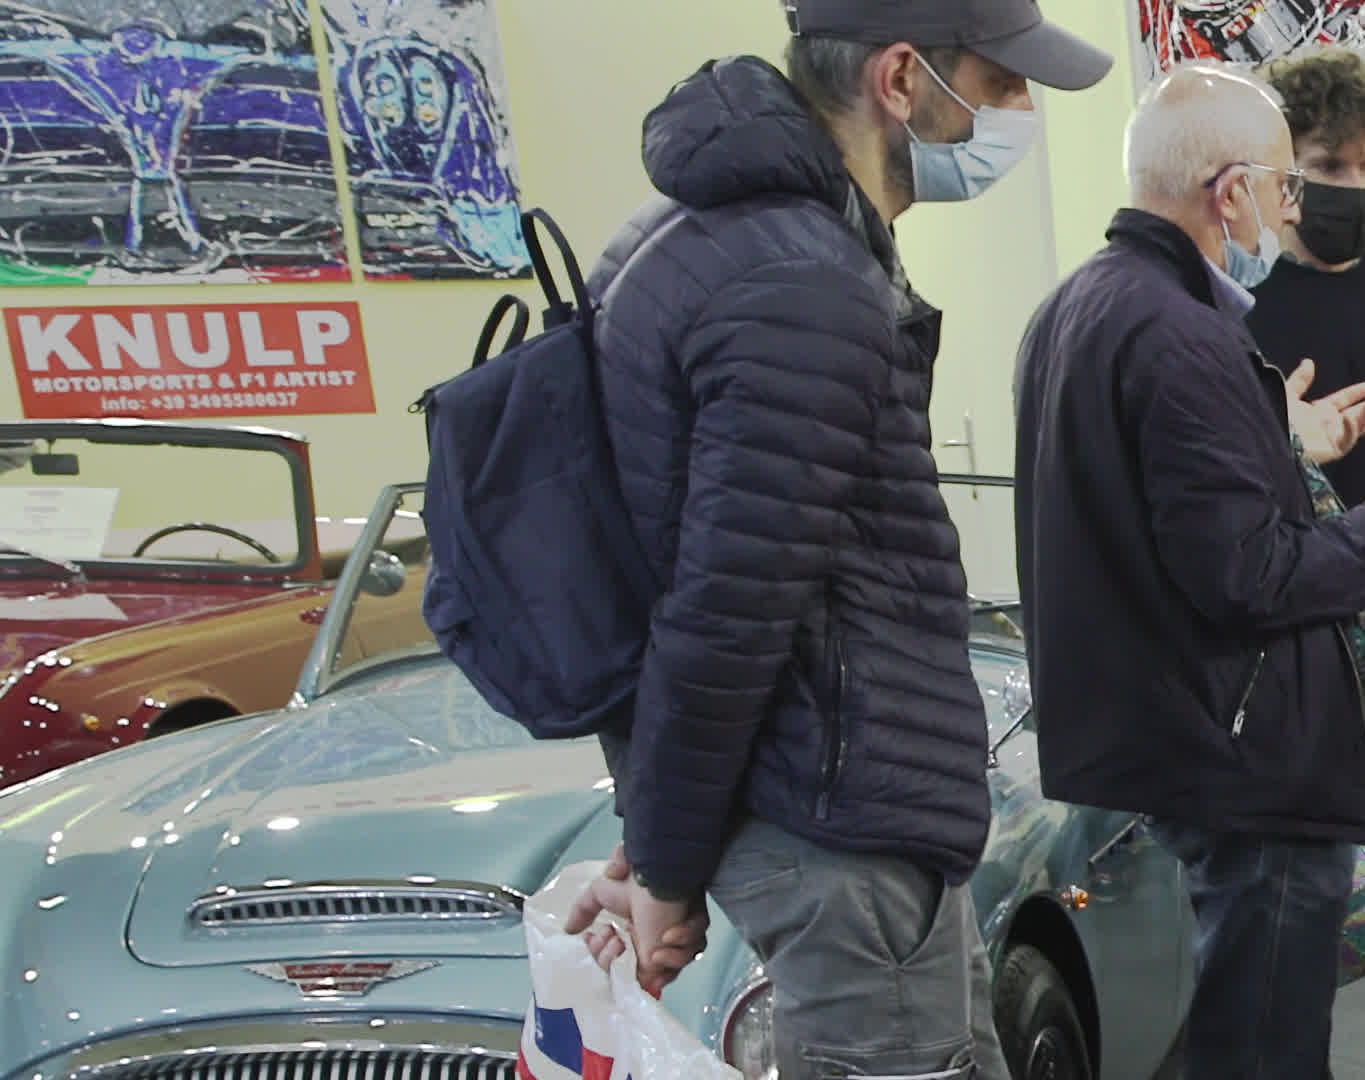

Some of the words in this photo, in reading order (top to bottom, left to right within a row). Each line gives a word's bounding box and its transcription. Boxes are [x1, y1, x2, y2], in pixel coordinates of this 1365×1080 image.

[17, 309, 351, 372] KNULP
[31, 374, 212, 393] MOTORSPORTS
[218, 372, 236, 390] &
[239, 372, 268, 389] F1
[272, 370, 357, 388] ARTIST
